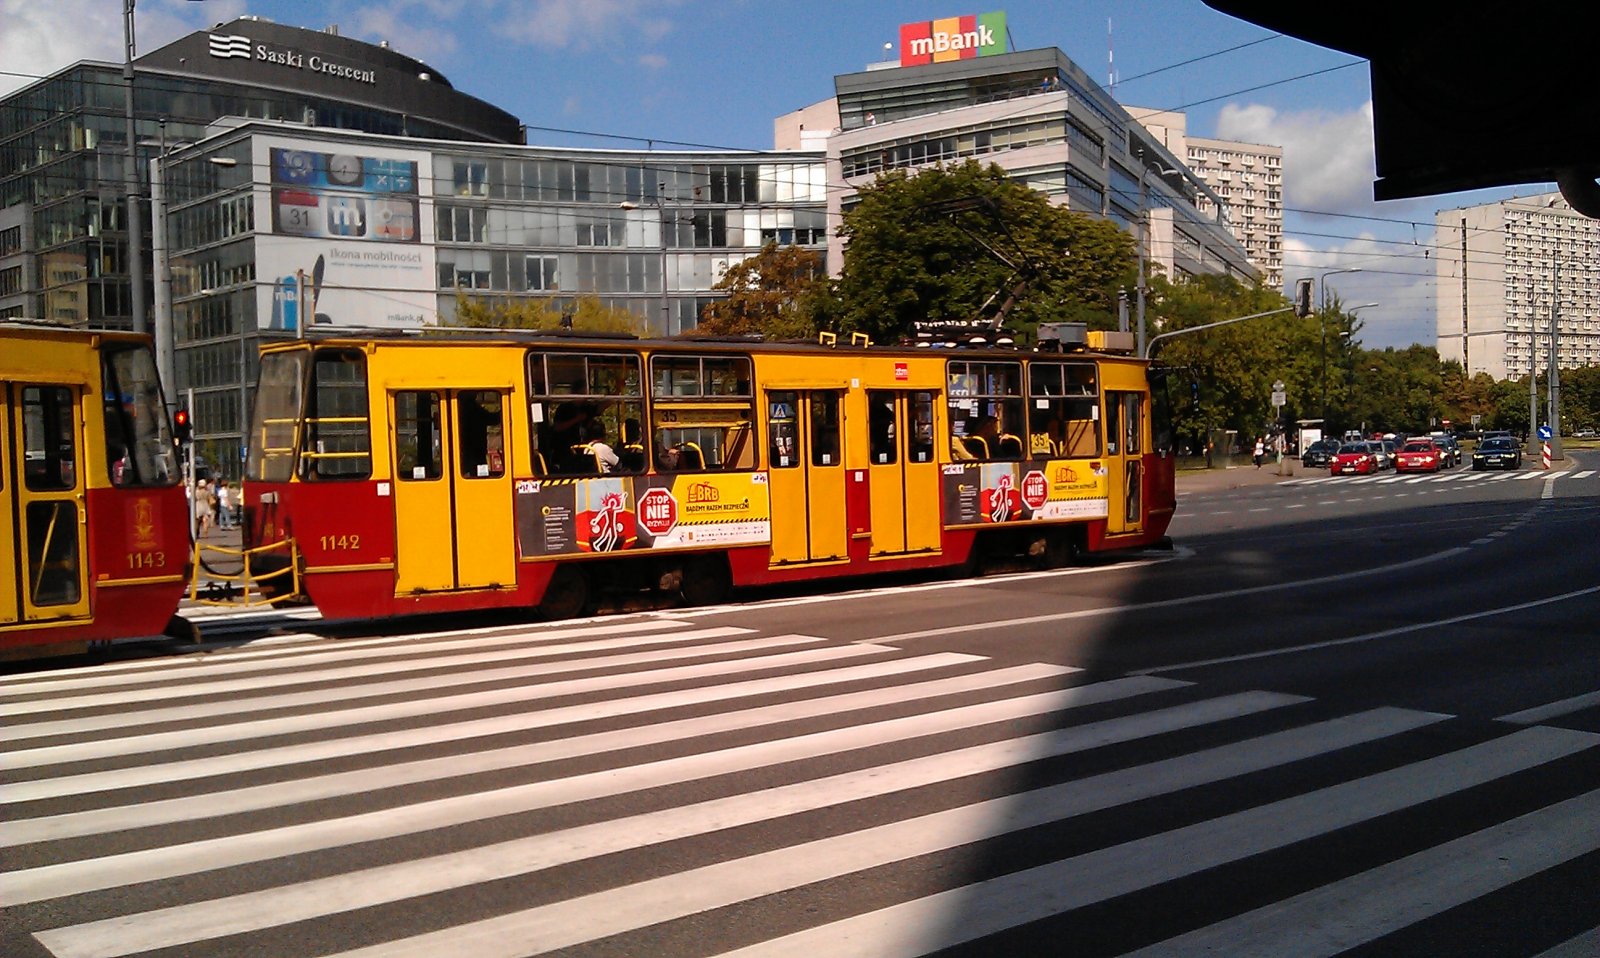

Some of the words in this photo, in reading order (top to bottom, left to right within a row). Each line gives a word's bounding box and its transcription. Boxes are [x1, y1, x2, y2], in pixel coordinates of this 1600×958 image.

[910, 25, 995, 55] mBank
[257, 44, 302, 68] Saski
[309, 56, 376, 84] Crescent
[290, 208, 309, 228] 31
[329, 248, 360, 260] Ikona
[363, 251, 422, 263] mobilności
[661, 410, 677, 422] 35
[1034, 434, 1045, 447] 35
[697, 484, 719, 501] BRB
[1027, 484, 1044, 496] NIE
[646, 504, 670, 520] NIE
[320, 535, 360, 550] 1142
[126, 552, 165, 569] 1143
